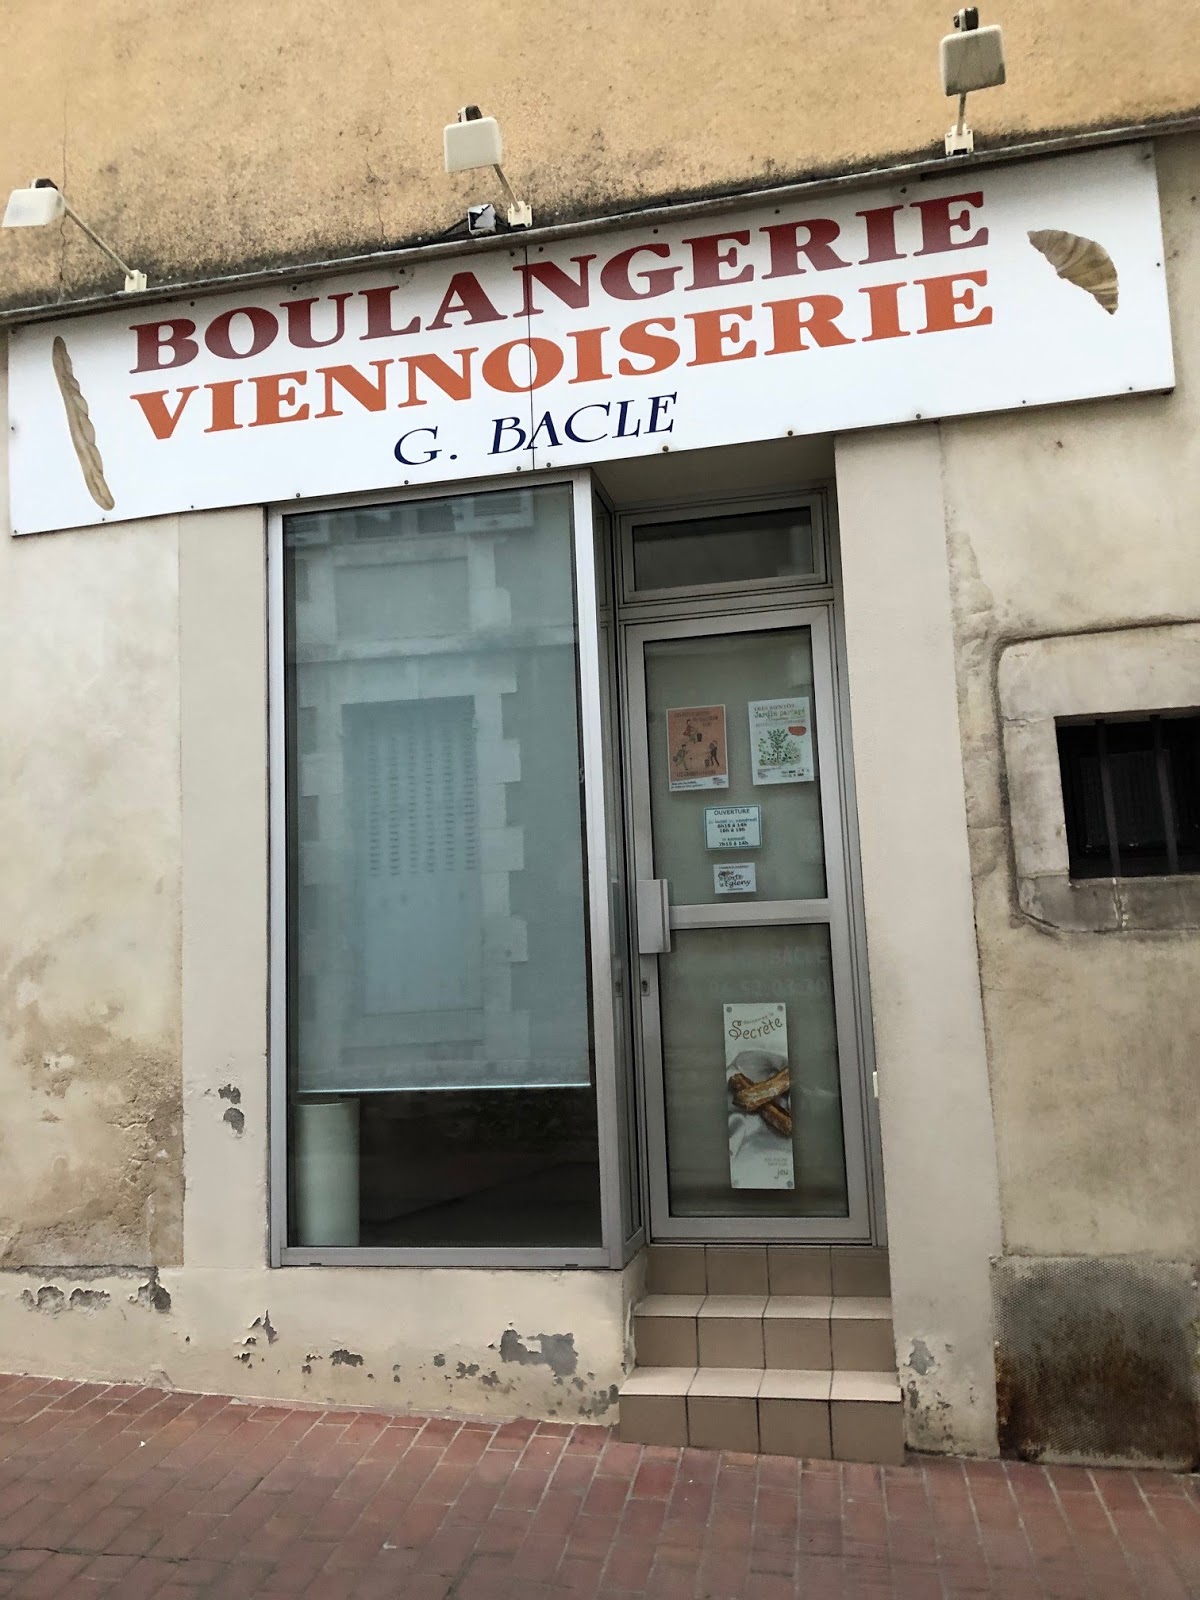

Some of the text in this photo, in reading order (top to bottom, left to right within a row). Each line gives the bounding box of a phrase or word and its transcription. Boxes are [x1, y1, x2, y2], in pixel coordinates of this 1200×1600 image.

[129, 191, 989, 375] BOULANGERIE
[130, 270, 994, 440] VIENNOISERIE
[394, 391, 678, 467] G. BACLE
[729, 1017, 783, 1041] Secrète
